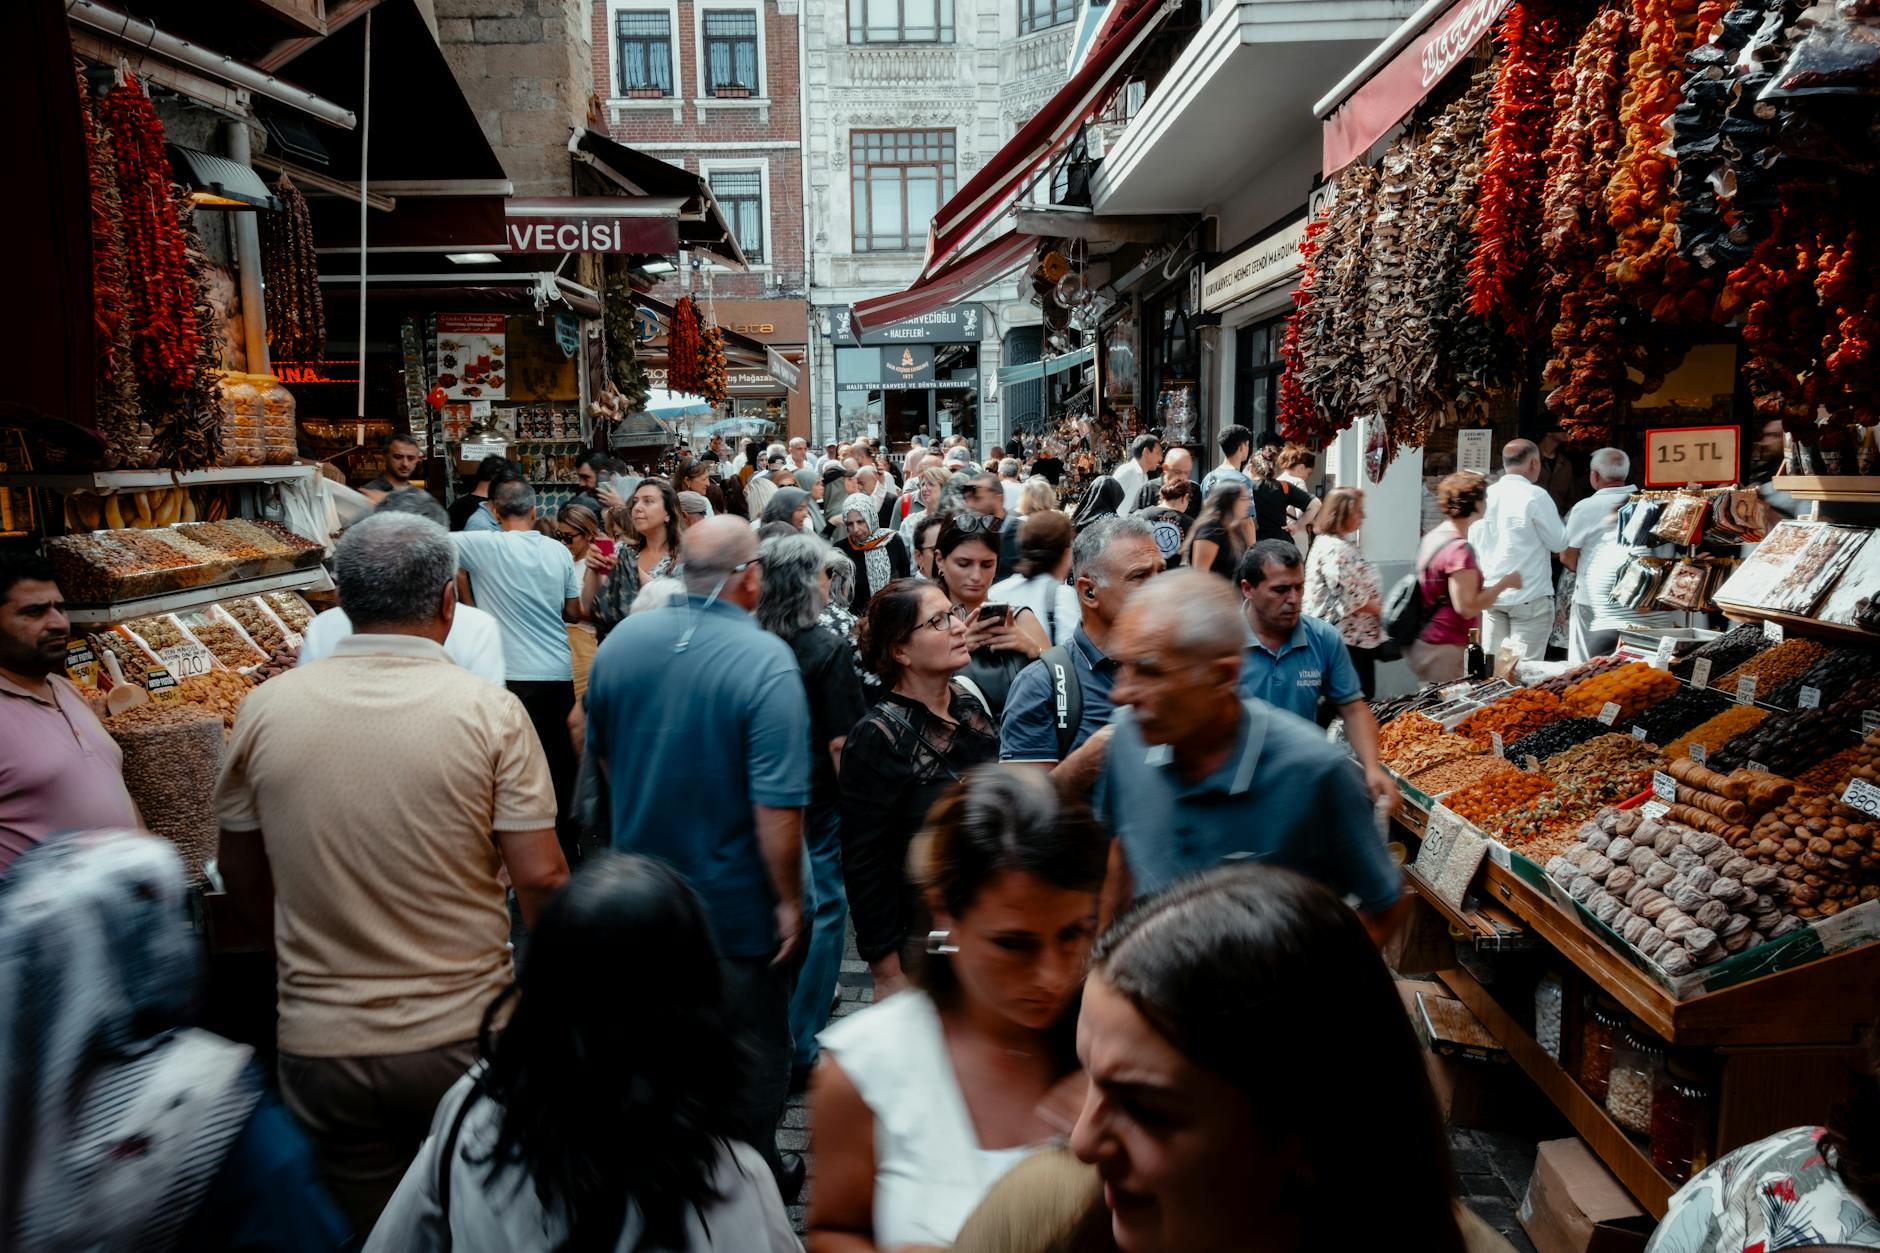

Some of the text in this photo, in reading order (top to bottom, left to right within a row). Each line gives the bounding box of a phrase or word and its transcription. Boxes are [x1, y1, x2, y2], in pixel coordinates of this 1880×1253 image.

[890, 327, 924, 339] HALEFLERİ
[918, 380, 937, 388] DÜNYA
[1657, 441, 1723, 463] 15 TL
[1054, 663, 1068, 729] HEAD
[1843, 790, 1877, 812] 380
